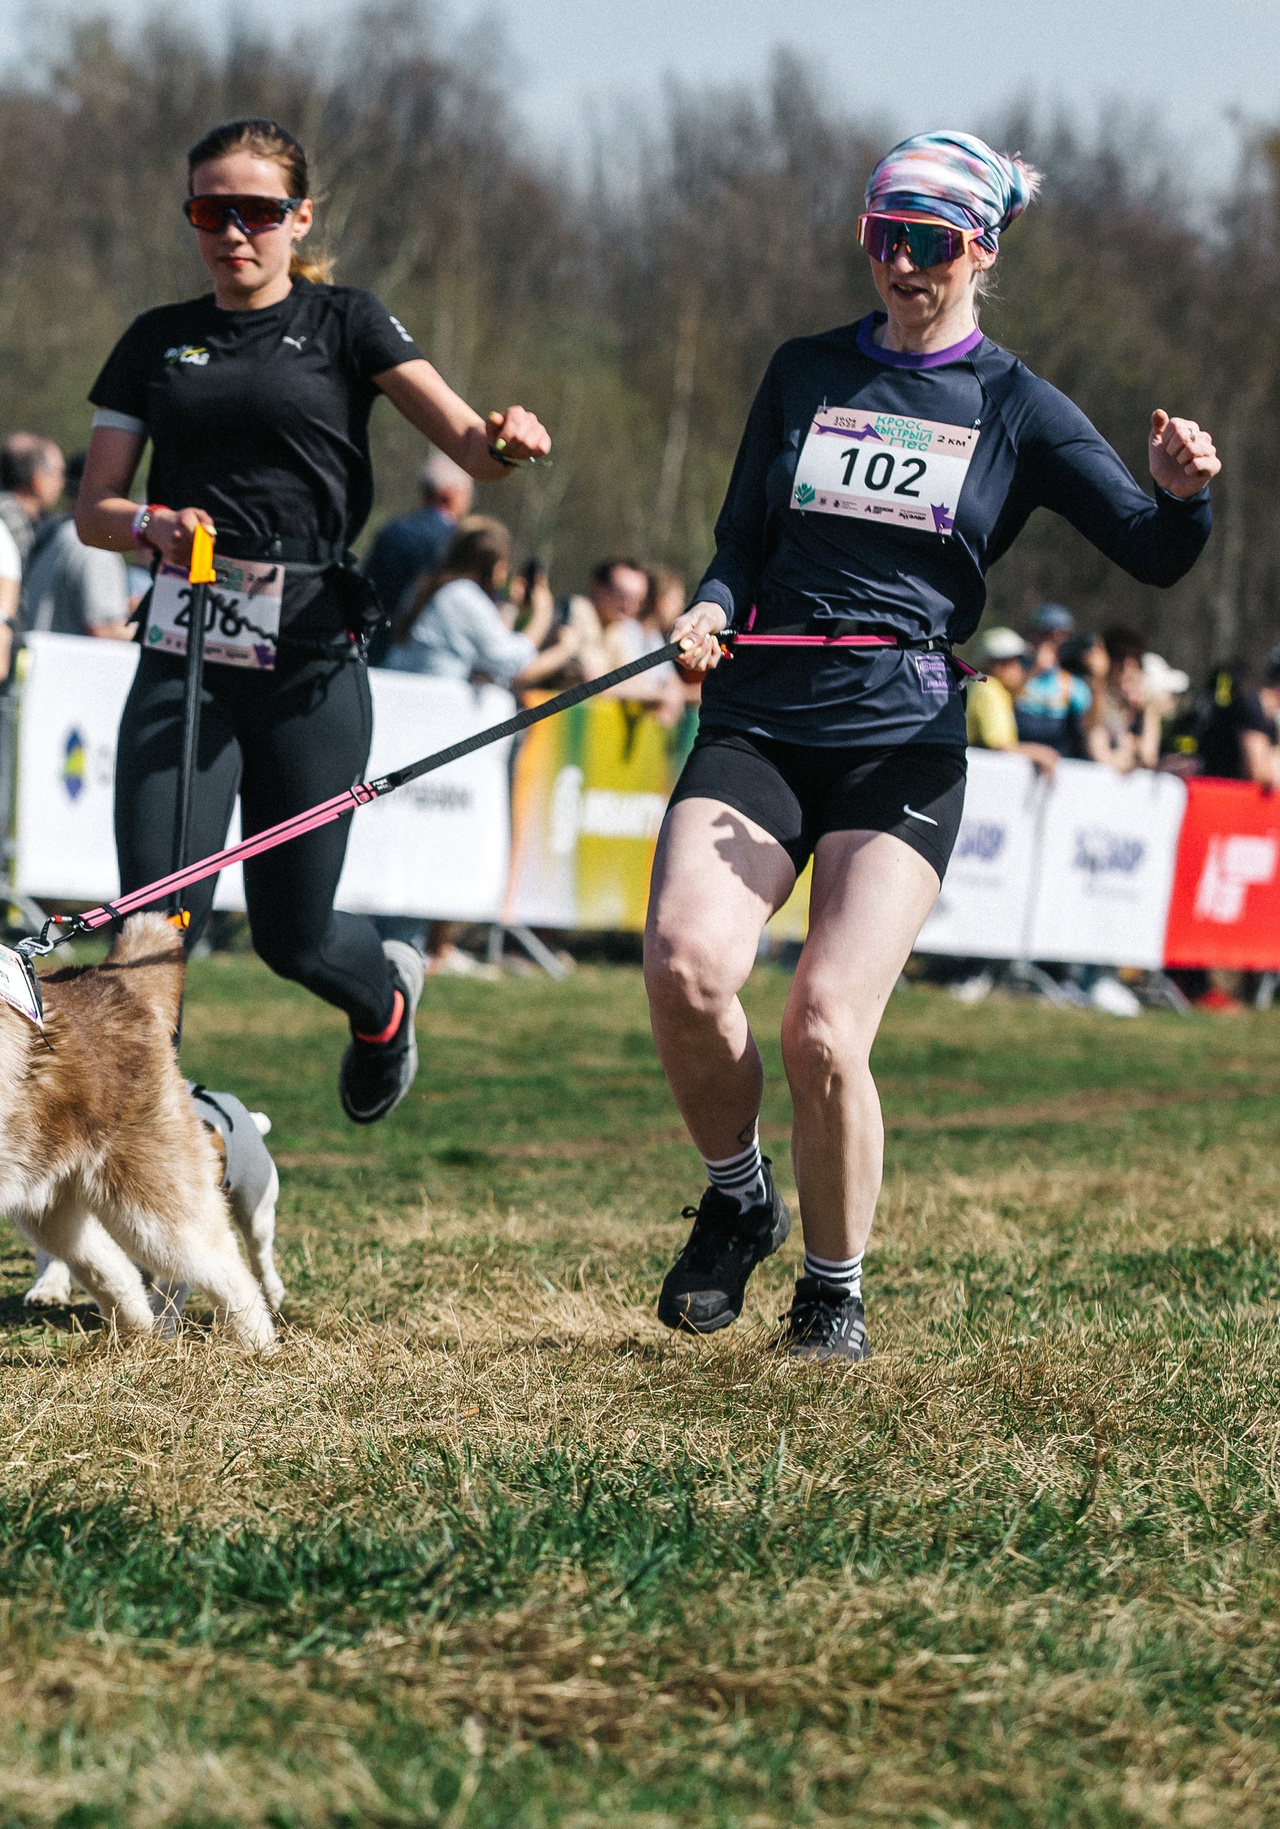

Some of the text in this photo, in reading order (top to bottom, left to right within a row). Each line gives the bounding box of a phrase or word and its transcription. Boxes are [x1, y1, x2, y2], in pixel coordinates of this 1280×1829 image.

[876, 415, 925, 431] КРОСС
[874, 425, 934, 443] БЫСТРЫЙ
[937, 435, 945, 443] 2
[840, 447, 928, 498] 102
